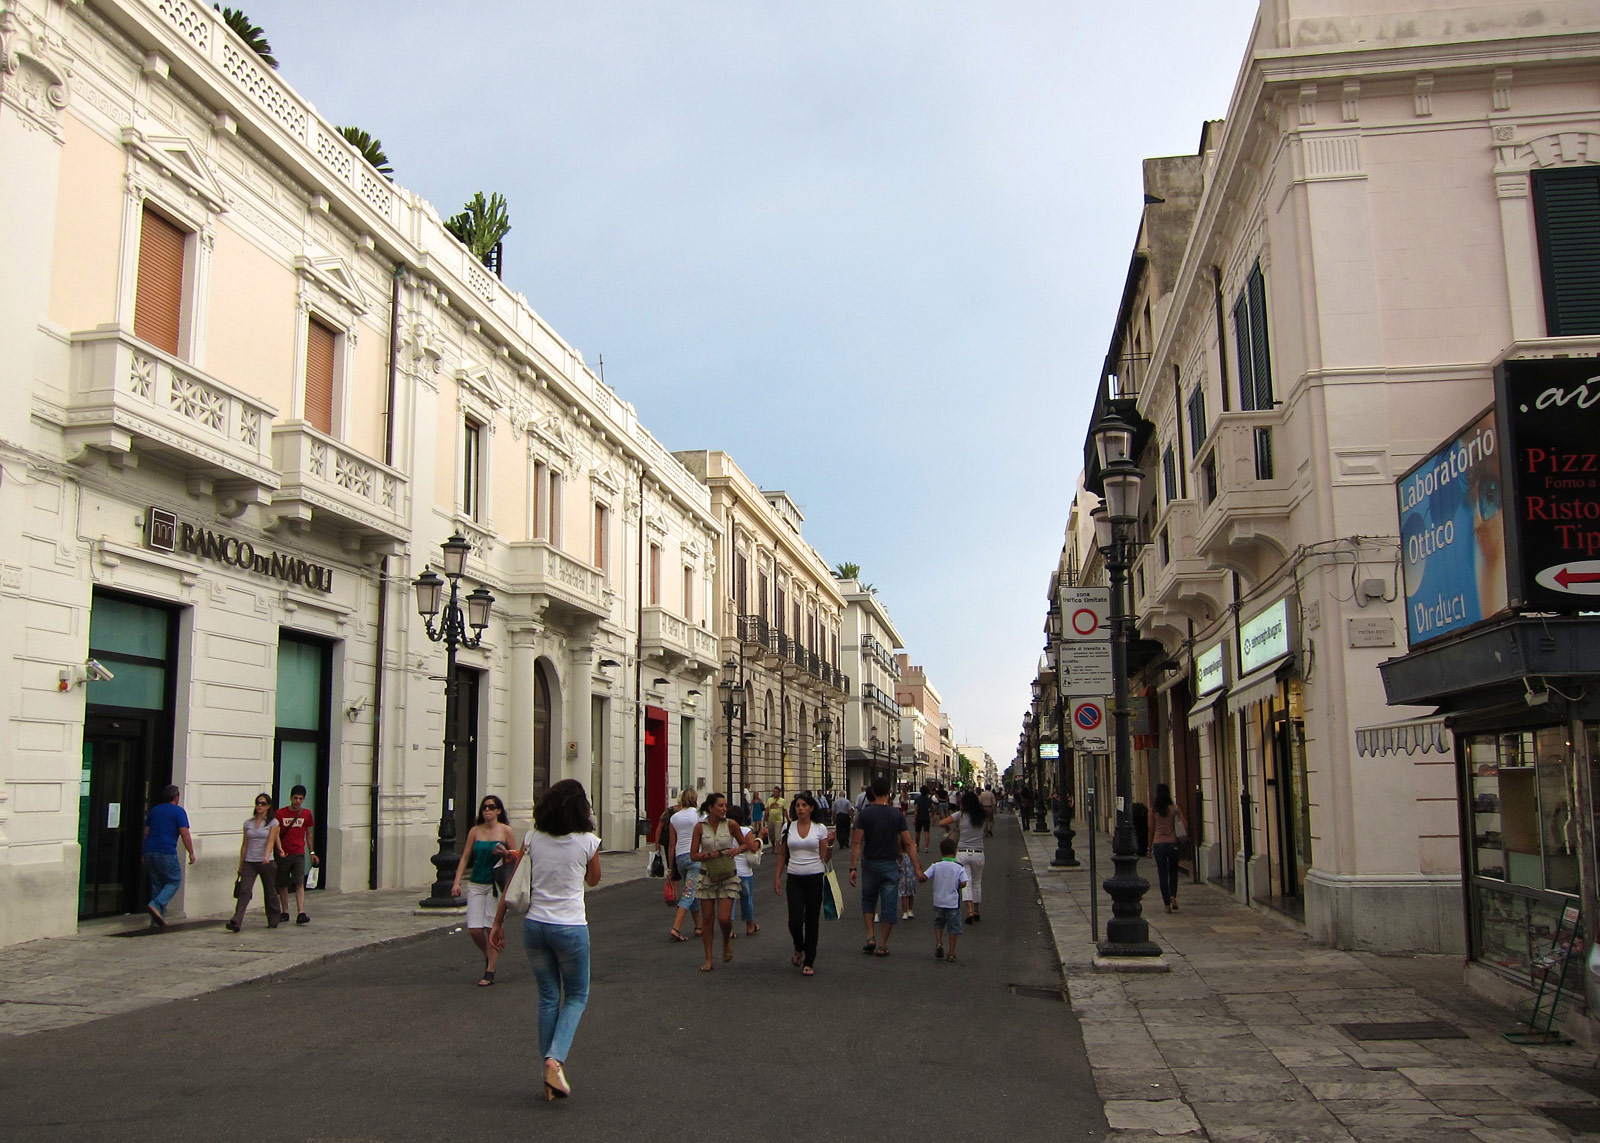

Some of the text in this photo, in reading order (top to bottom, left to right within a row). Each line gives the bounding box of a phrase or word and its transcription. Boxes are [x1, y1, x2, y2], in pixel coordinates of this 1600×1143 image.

[1400, 428, 1495, 514] Laboratorio
[1526, 446, 1598, 473] Pizz
[1545, 476, 1585, 489] Forno
[1526, 495, 1600, 521] Risto
[1408, 520, 1455, 565] Ottico
[1554, 524, 1600, 556] Tip
[181, 522, 334, 594] BANCO DI NAPOLI
